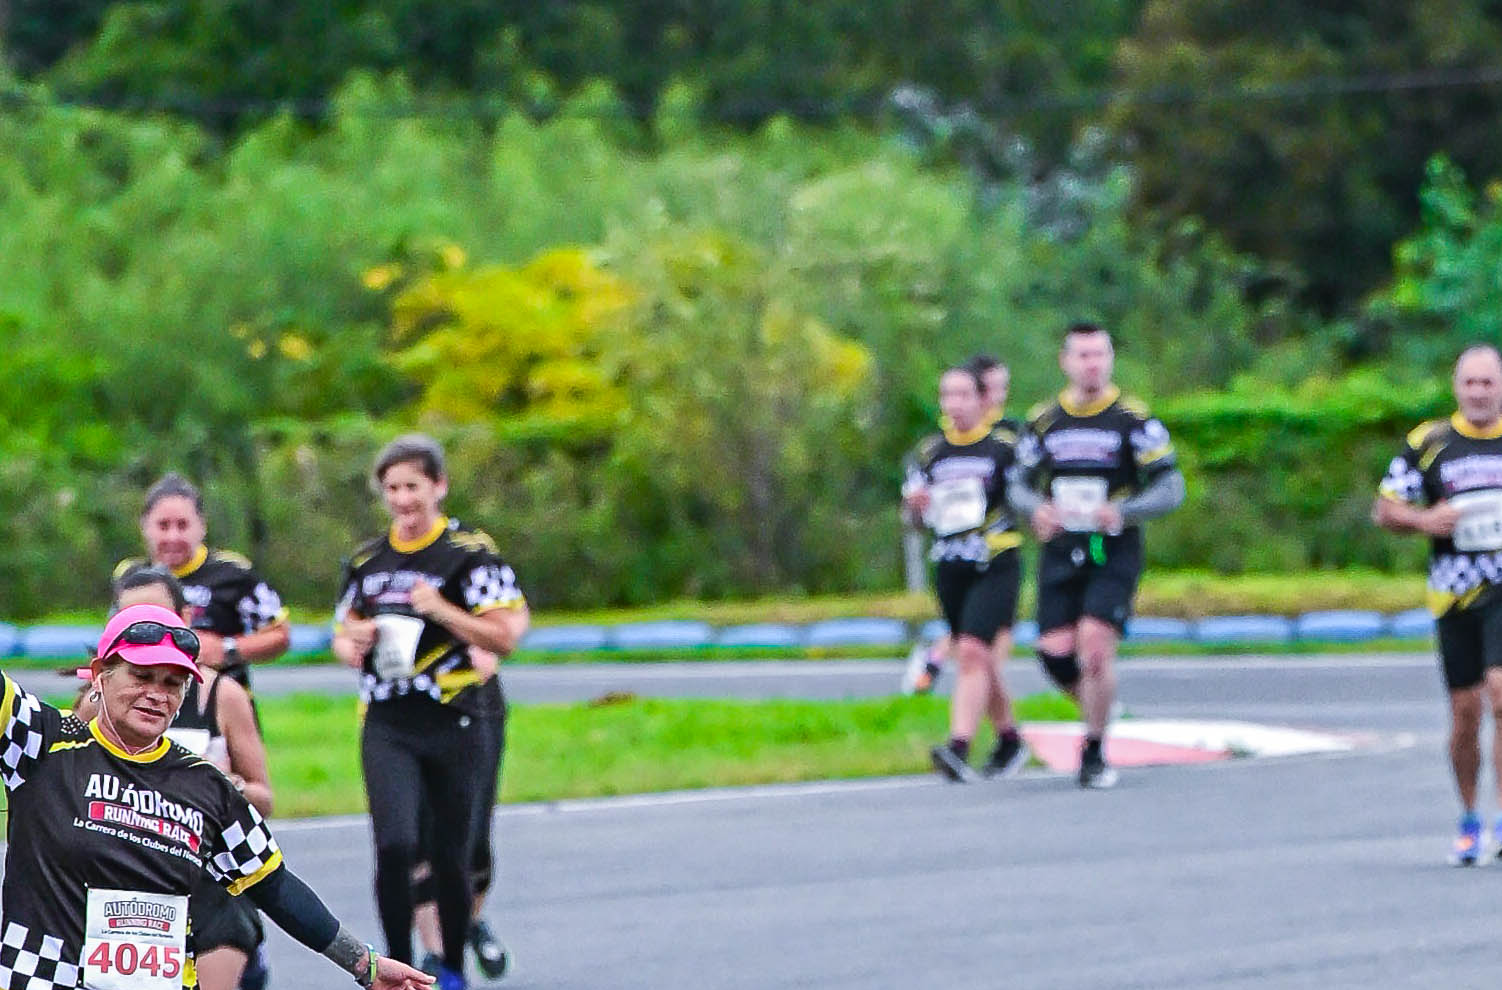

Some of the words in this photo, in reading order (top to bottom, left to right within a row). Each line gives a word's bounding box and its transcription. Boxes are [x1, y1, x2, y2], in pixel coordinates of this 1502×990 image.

[84, 773, 204, 837] AUÓDROMO
[104, 805, 160, 833] RUNNING
[73, 817, 85, 828] La
[85, 820, 117, 837] Carrera
[117, 829, 129, 840] de
[129, 832, 141, 844] los
[141, 837, 169, 853] Clubes
[169, 845, 183, 857] del
[104, 897, 177, 922] AUTÓDROMO
[87, 942, 181, 979] 4045
